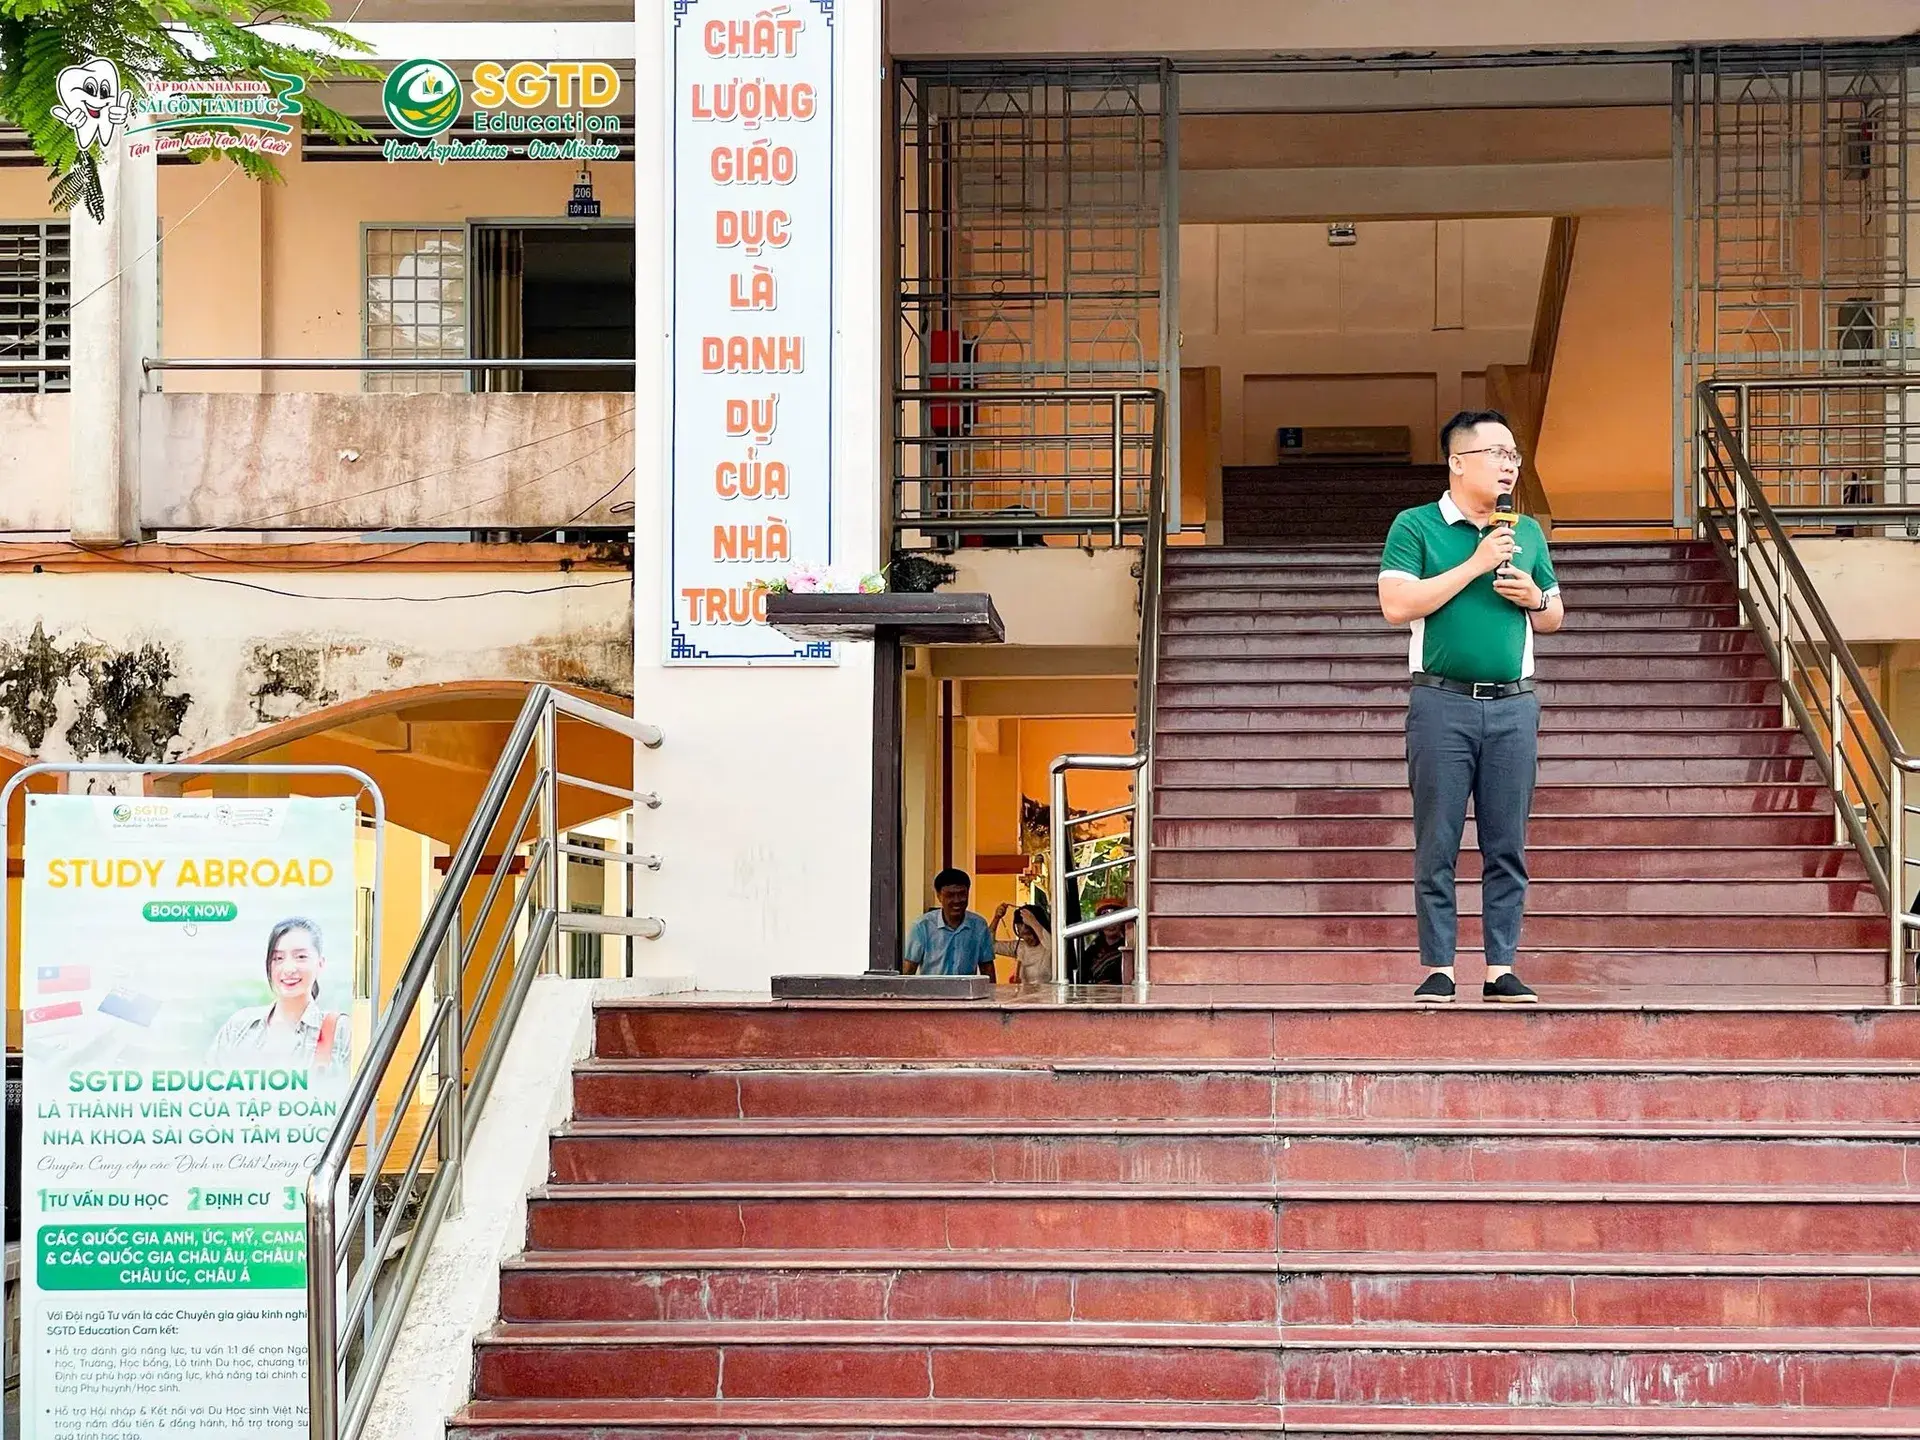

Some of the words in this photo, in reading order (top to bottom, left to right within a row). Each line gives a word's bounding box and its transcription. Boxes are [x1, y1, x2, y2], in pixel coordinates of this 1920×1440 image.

[704, 5, 804, 57] CHẤT
[692, 77, 816, 129] LƯỢNG
[711, 138, 797, 185] GIÁO
[575, 187, 591, 198] 206
[716, 209, 791, 256] DỤC
[730, 264, 777, 310] LÀ
[702, 336, 804, 373] DANH
[726, 393, 779, 445] DỰ
[716, 446, 789, 499] CỦA
[713, 516, 790, 562] NHÀ
[682, 578, 767, 625] TRƯỜ
[47, 858, 166, 889] STUDY
[176, 858, 334, 888] ABROAD
[150, 905, 191, 917] BOOK
[194, 904, 230, 917] NOW
[69, 1070, 143, 1092] SGTD
[152, 1069, 308, 1091] EDUCATION
[37, 1099, 61, 1118] LÀ
[67, 1099, 133, 1118] THÀNH
[140, 1098, 182, 1118] VIÊN
[189, 1097, 230, 1117] CỦA
[236, 1097, 272, 1121] TẬP
[278, 1096, 336, 1117] ĐOÀN
[43, 1129, 84, 1145] NHA
[91, 1129, 146, 1145] KHOA
[152, 1125, 182, 1144] SÀI
[189, 1124, 234, 1144] GÒN
[240, 1124, 280, 1143] TÂM
[287, 1123, 329, 1143] ĐỨC
[89, 1154, 122, 1179] Cung
[37, 1188, 47, 1212] 1
[49, 1194, 69, 1207] TƯ
[73, 1189, 103, 1207] VẤN
[106, 1194, 129, 1206] DU
[135, 1194, 169, 1210] HỌC
[187, 1187, 200, 1210] 2
[206, 1193, 243, 1209] ĐỊNH
[247, 1192, 270, 1206] CƯ
[283, 1186, 296, 1210] 3
[44, 1229, 79, 1246] CÁC
[82, 1227, 129, 1246] QUỐC
[132, 1231, 160, 1245] GIA
[163, 1231, 198, 1246] ANH,
[202, 1228, 227, 1246] ÚC,
[232, 1227, 258, 1246] MỸ,
[261, 1230, 306, 1244] CANA
[45, 1253, 57, 1265] &
[60, 1249, 94, 1264] CÁC
[97, 1247, 144, 1264] QUỐC
[147, 1251, 175, 1263] GIA
[178, 1247, 220, 1263] CHÂU
[223, 1247, 248, 1265] ÂU,
[251, 1247, 294, 1263] CHÂU
[119, 1267, 162, 1283] CHÂU
[165, 1266, 191, 1285] ÚC,
[194, 1266, 236, 1282] CHÂU
[176, 1310, 215, 1321] Chuyên
[218, 1310, 234, 1321] gia
[262, 1310, 282, 1319] kinh
[285, 1310, 308, 1321] nghi
[47, 1326, 76, 1335] SGTD
[79, 1325, 130, 1335] Education
[132, 1325, 157, 1335] Cam
[228, 1345, 238, 1354] 1:1
[216, 1358, 229, 1367] Du
[140, 1406, 146, 1415] &
[208, 1406, 222, 1415] Du
[249, 1406, 269, 1415] sinh
[159, 1419, 165, 1428] &
[267, 1419, 293, 1430] trong
